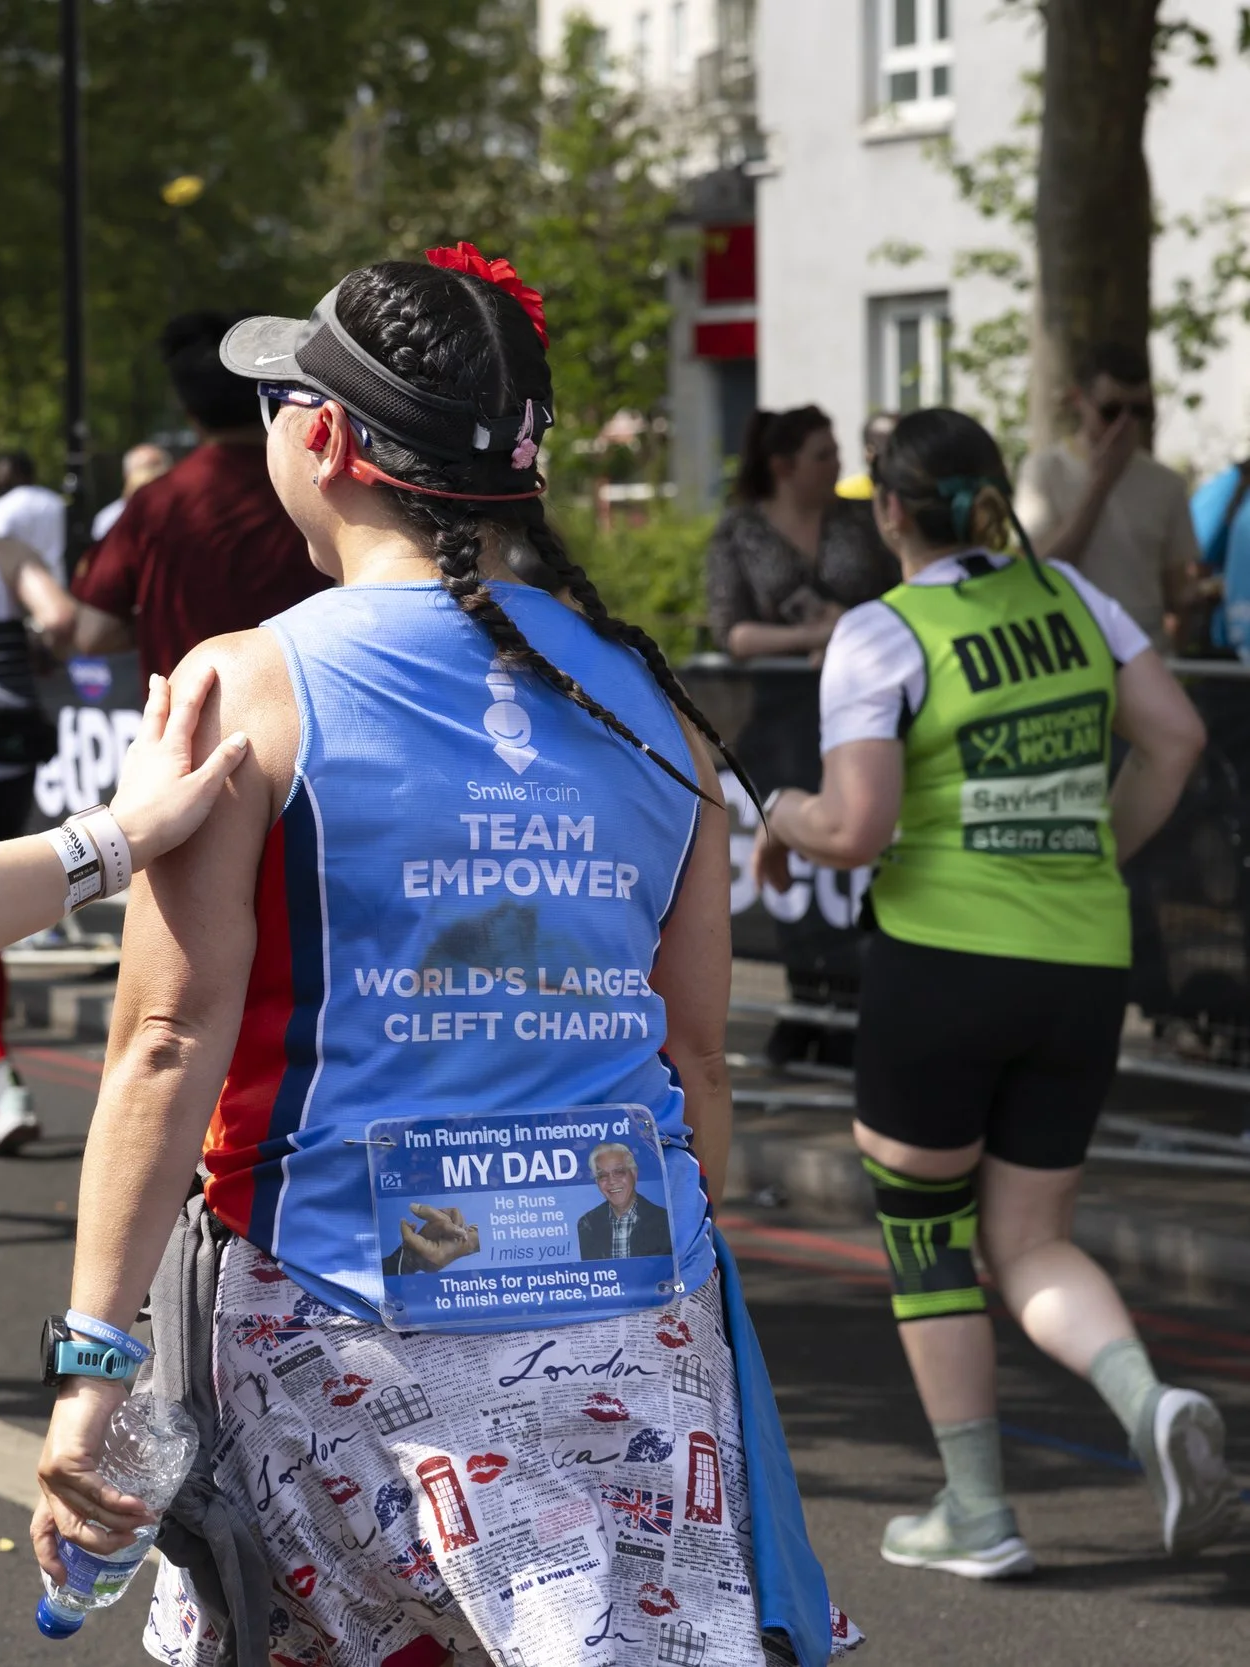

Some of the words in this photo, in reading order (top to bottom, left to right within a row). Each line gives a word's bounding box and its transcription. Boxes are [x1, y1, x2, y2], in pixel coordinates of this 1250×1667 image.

[953, 612, 1091, 694] DINA
[60, 824, 87, 859] IPRUN
[459, 813, 595, 852] TEAM
[972, 825, 1045, 850] stem
[402, 858, 640, 900] EMPOWER
[354, 966, 527, 998] WORLD'S
[383, 1011, 503, 1042] CLEFT
[513, 1011, 649, 1042] CHARITY
[405, 1130, 431, 1149] I'm
[435, 1126, 510, 1147] Running
[515, 1123, 531, 1142] in
[535, 1121, 609, 1141] memory
[612, 1117, 630, 1136] of
[441, 1153, 494, 1188] MY
[502, 1148, 578, 1184] DAD
[495, 1196, 514, 1210] He
[518, 1195, 556, 1209] Runs
[490, 1212, 538, 1226] beside
[542, 1211, 564, 1222] me
[492, 1227, 506, 1241] in
[510, 1223, 569, 1240] Heaven!
[490, 1246, 495, 1261] I
[499, 1245, 534, 1261] miss
[538, 1241, 571, 1261] you!
[435, 1295, 452, 1310] to
[455, 1292, 499, 1308] finish
[502, 1289, 545, 1305] every
[549, 1286, 587, 1302] race,
[590, 1283, 626, 1298] Dad.
[439, 1276, 498, 1293] Thanks
[501, 1274, 522, 1289] for
[527, 1269, 590, 1291] pushing
[593, 1269, 617, 1282] me
[93, 1325, 124, 1345] Smile
[499, 1340, 660, 1387] London
